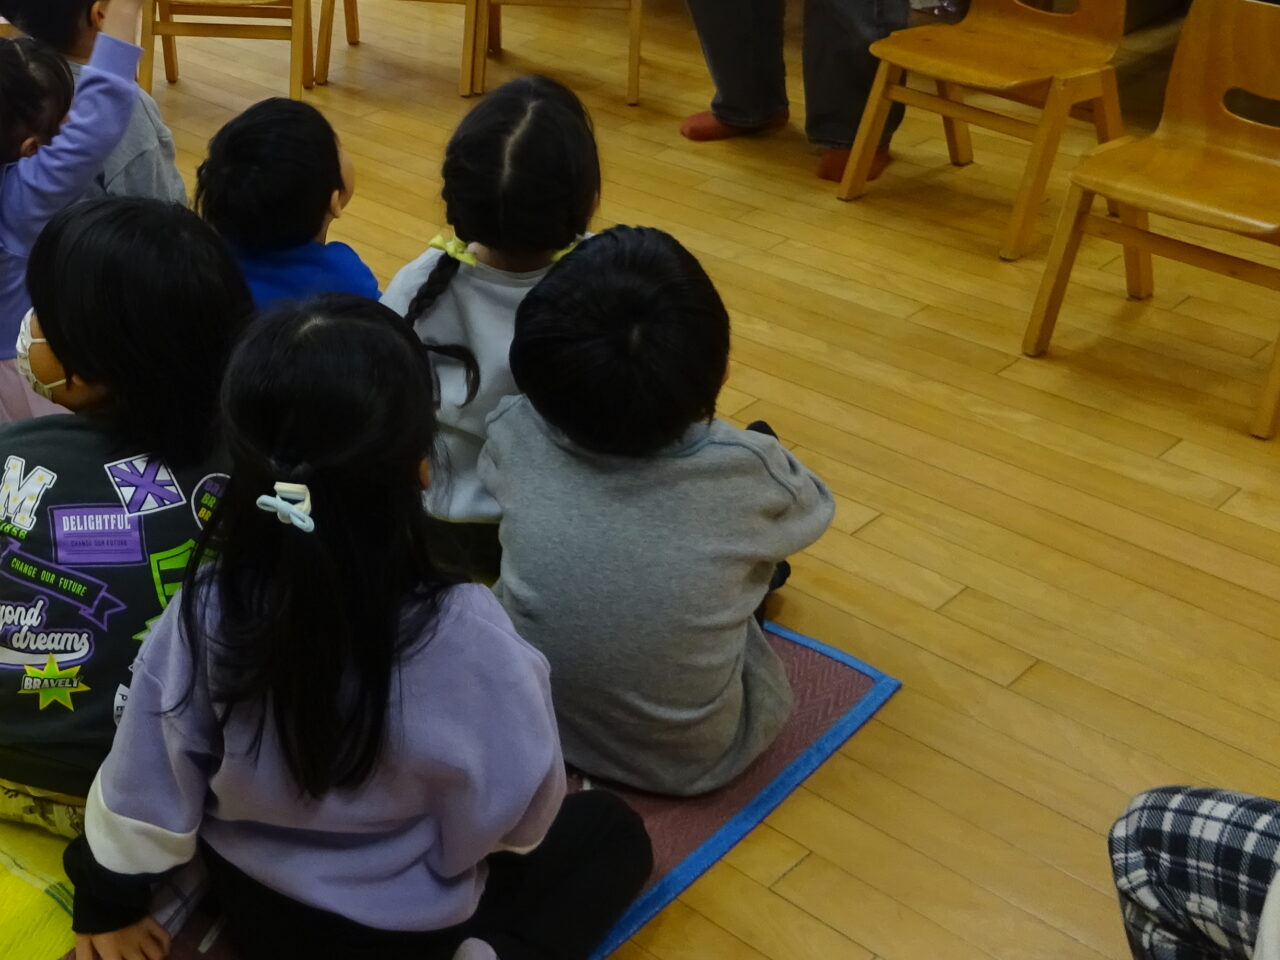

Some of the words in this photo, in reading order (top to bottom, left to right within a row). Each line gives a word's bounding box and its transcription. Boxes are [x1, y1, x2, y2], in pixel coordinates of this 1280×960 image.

[62, 513, 131, 532] DELIGHTFUL
[11, 557, 38, 578] CHANGE
[40, 569, 56, 584] OUR
[59, 577, 87, 597] FUTURE
[12, 625, 90, 651] dreams
[23, 676, 79, 690] BRAVELY
